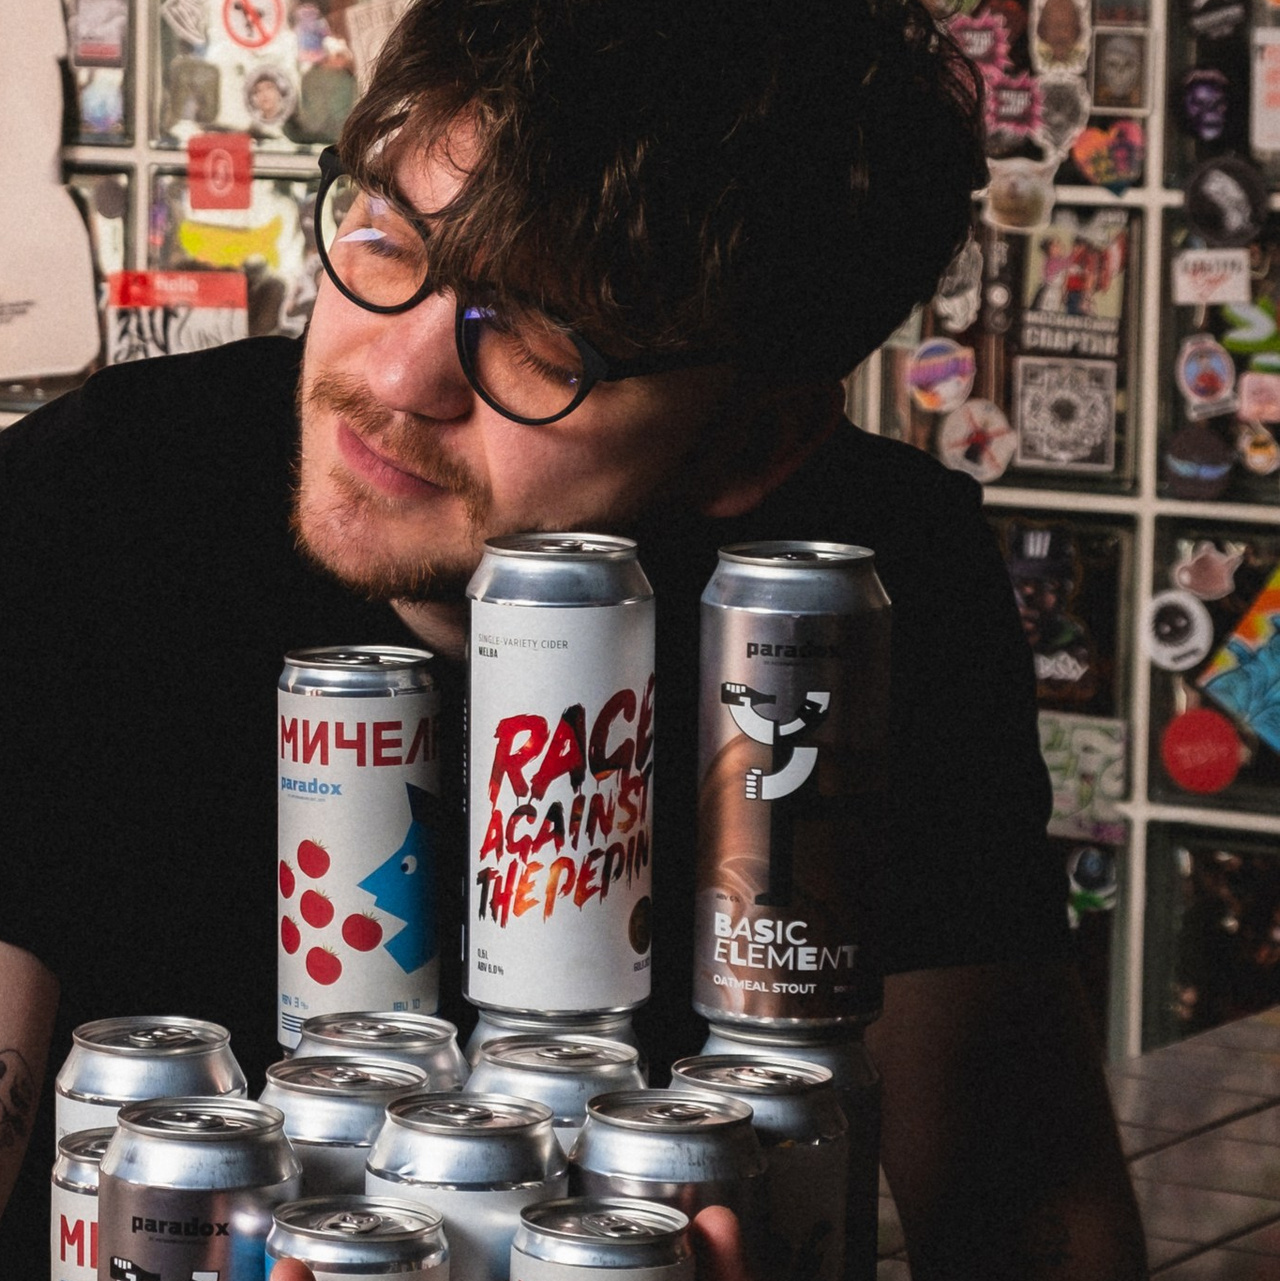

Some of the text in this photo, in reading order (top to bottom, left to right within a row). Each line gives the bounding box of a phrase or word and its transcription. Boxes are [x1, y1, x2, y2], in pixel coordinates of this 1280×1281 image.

[478, 634, 569, 650] SINGLE-VARIETY CIDER
[478, 646, 498, 659] MELBA
[281, 715, 438, 768] МИЧЕЛ
[281, 776, 342, 796] paradox
[714, 911, 808, 946] BASIC
[713, 937, 859, 971] ELEMENT
[713, 973, 769, 993] OATMEAL
[772, 981, 817, 994] STOUT
[132, 1216, 229, 1237] paradox
